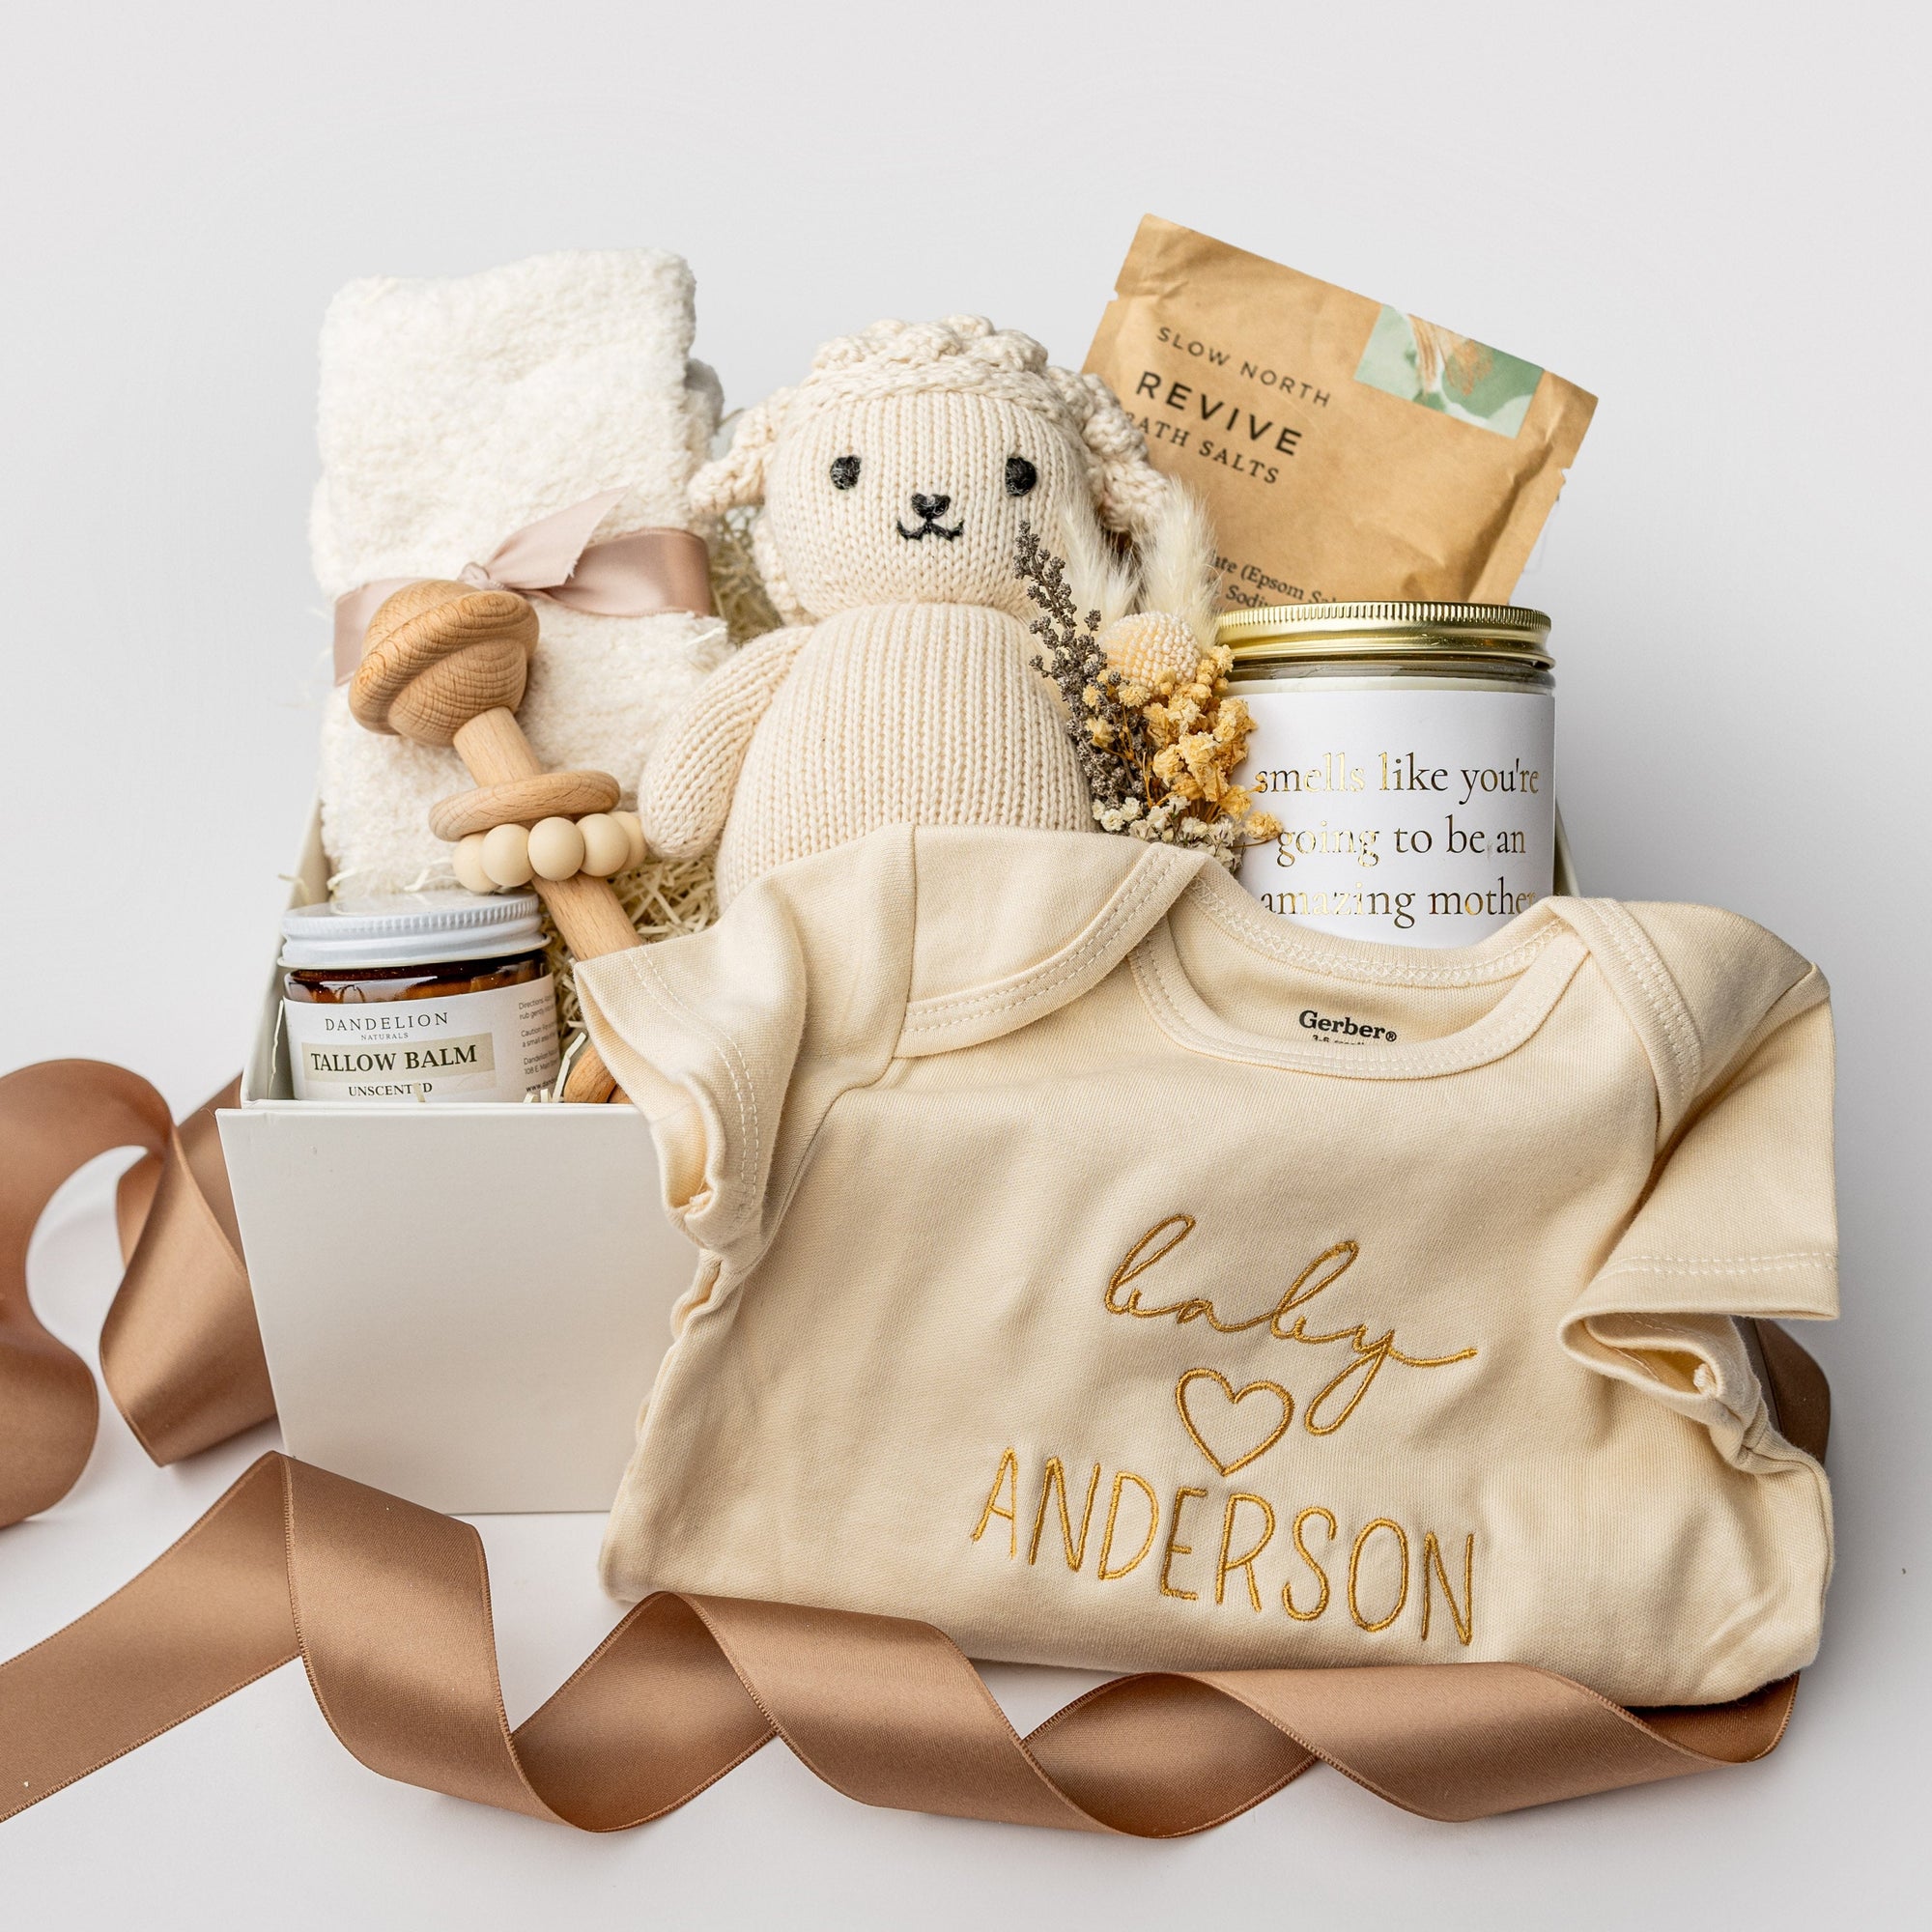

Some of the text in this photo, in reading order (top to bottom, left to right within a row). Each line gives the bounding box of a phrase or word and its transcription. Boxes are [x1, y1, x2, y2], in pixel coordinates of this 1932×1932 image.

[1157, 327, 1330, 407] SLOW NORTH
[1136, 371, 1302, 456] REVIVE
[1198, 440, 1280, 484] SALTS
[1240, 564, 1304, 601] (Epsom
[1256, 752, 1539, 805] smells like you're
[1276, 814, 1526, 867] going to be an
[1261, 876, 1536, 928] amazing mother
[325, 1012, 448, 1031] DANDELION
[311, 1044, 477, 1071] TALLOW BALM
[349, 1082, 433, 1096] UNSCENTD
[1104, 1213, 1477, 1435] baby
[970, 1447, 1475, 1645] ANDERSON
